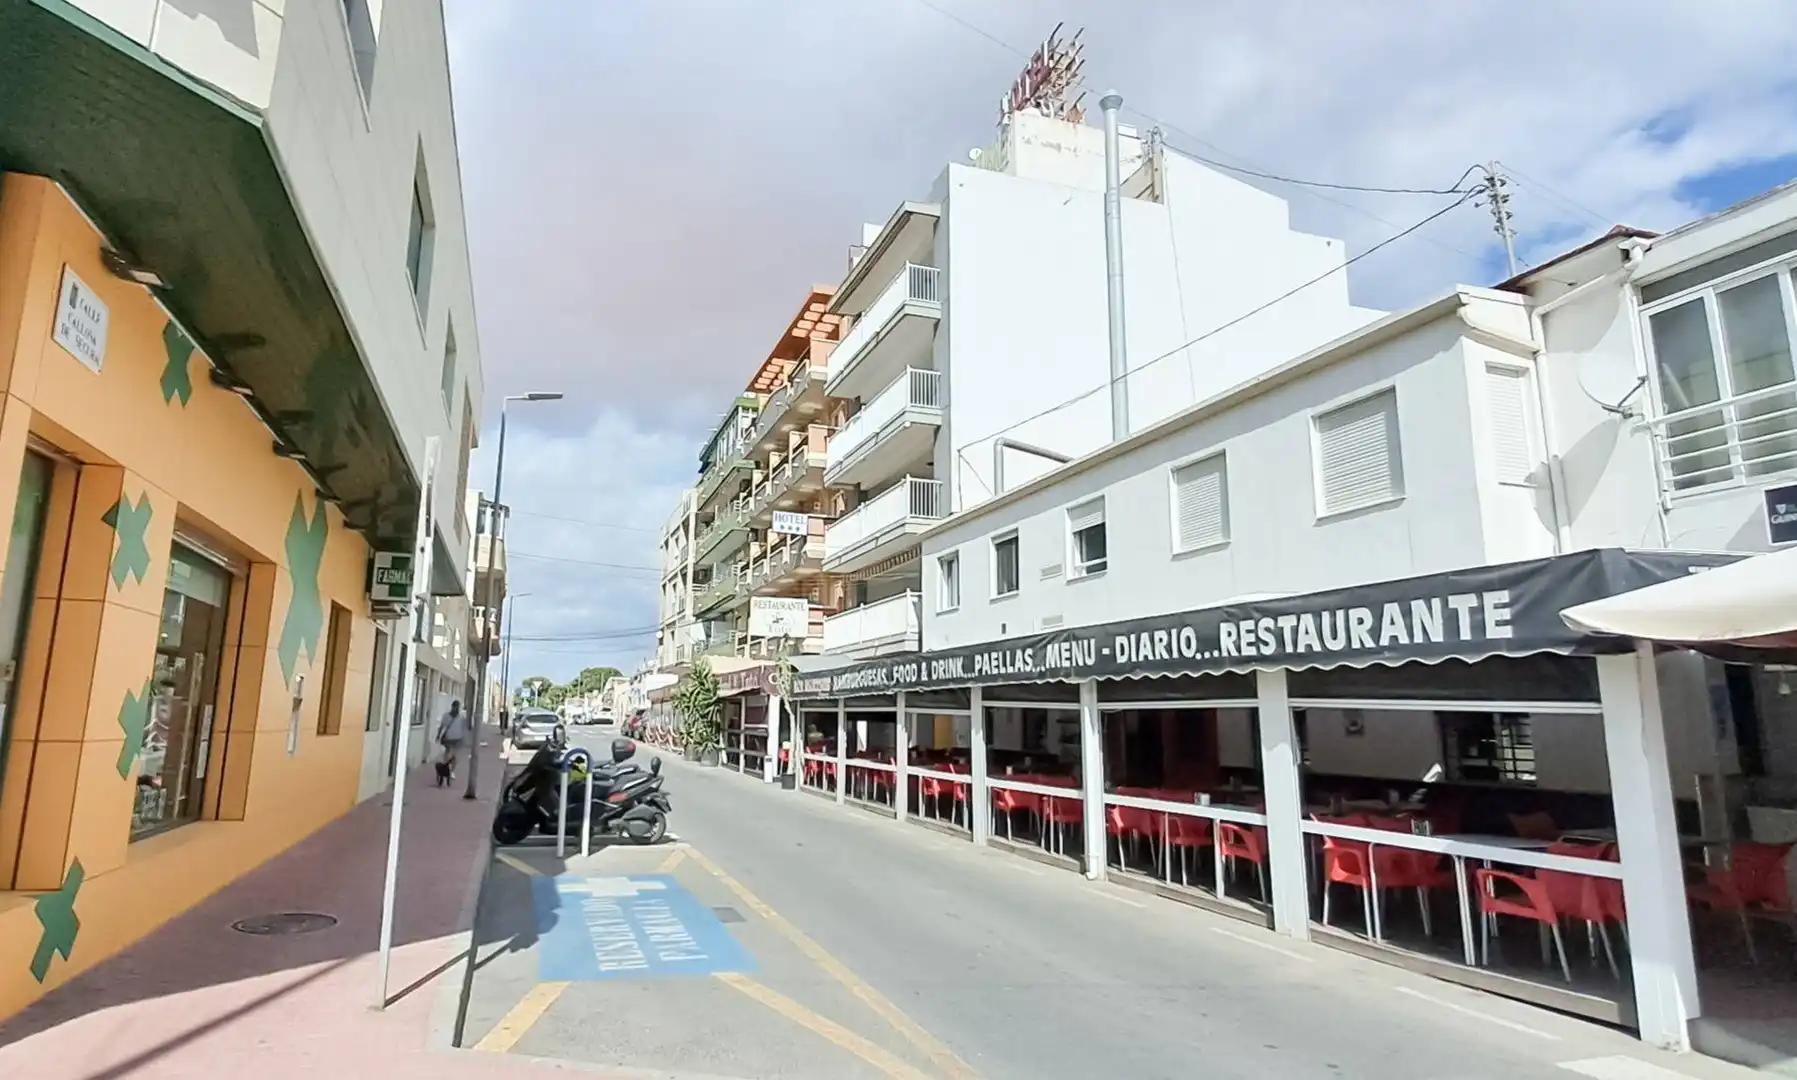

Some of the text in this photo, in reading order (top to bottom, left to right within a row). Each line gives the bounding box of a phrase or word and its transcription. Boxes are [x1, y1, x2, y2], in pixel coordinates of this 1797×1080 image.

[774, 512, 807, 525] HOTEL
[754, 600, 806, 612] RESTAURANTE
[921, 662, 928, 681] &
[1045, 638, 1096, 669] MENU
[1219, 589, 1513, 658] RESTAURANTE
